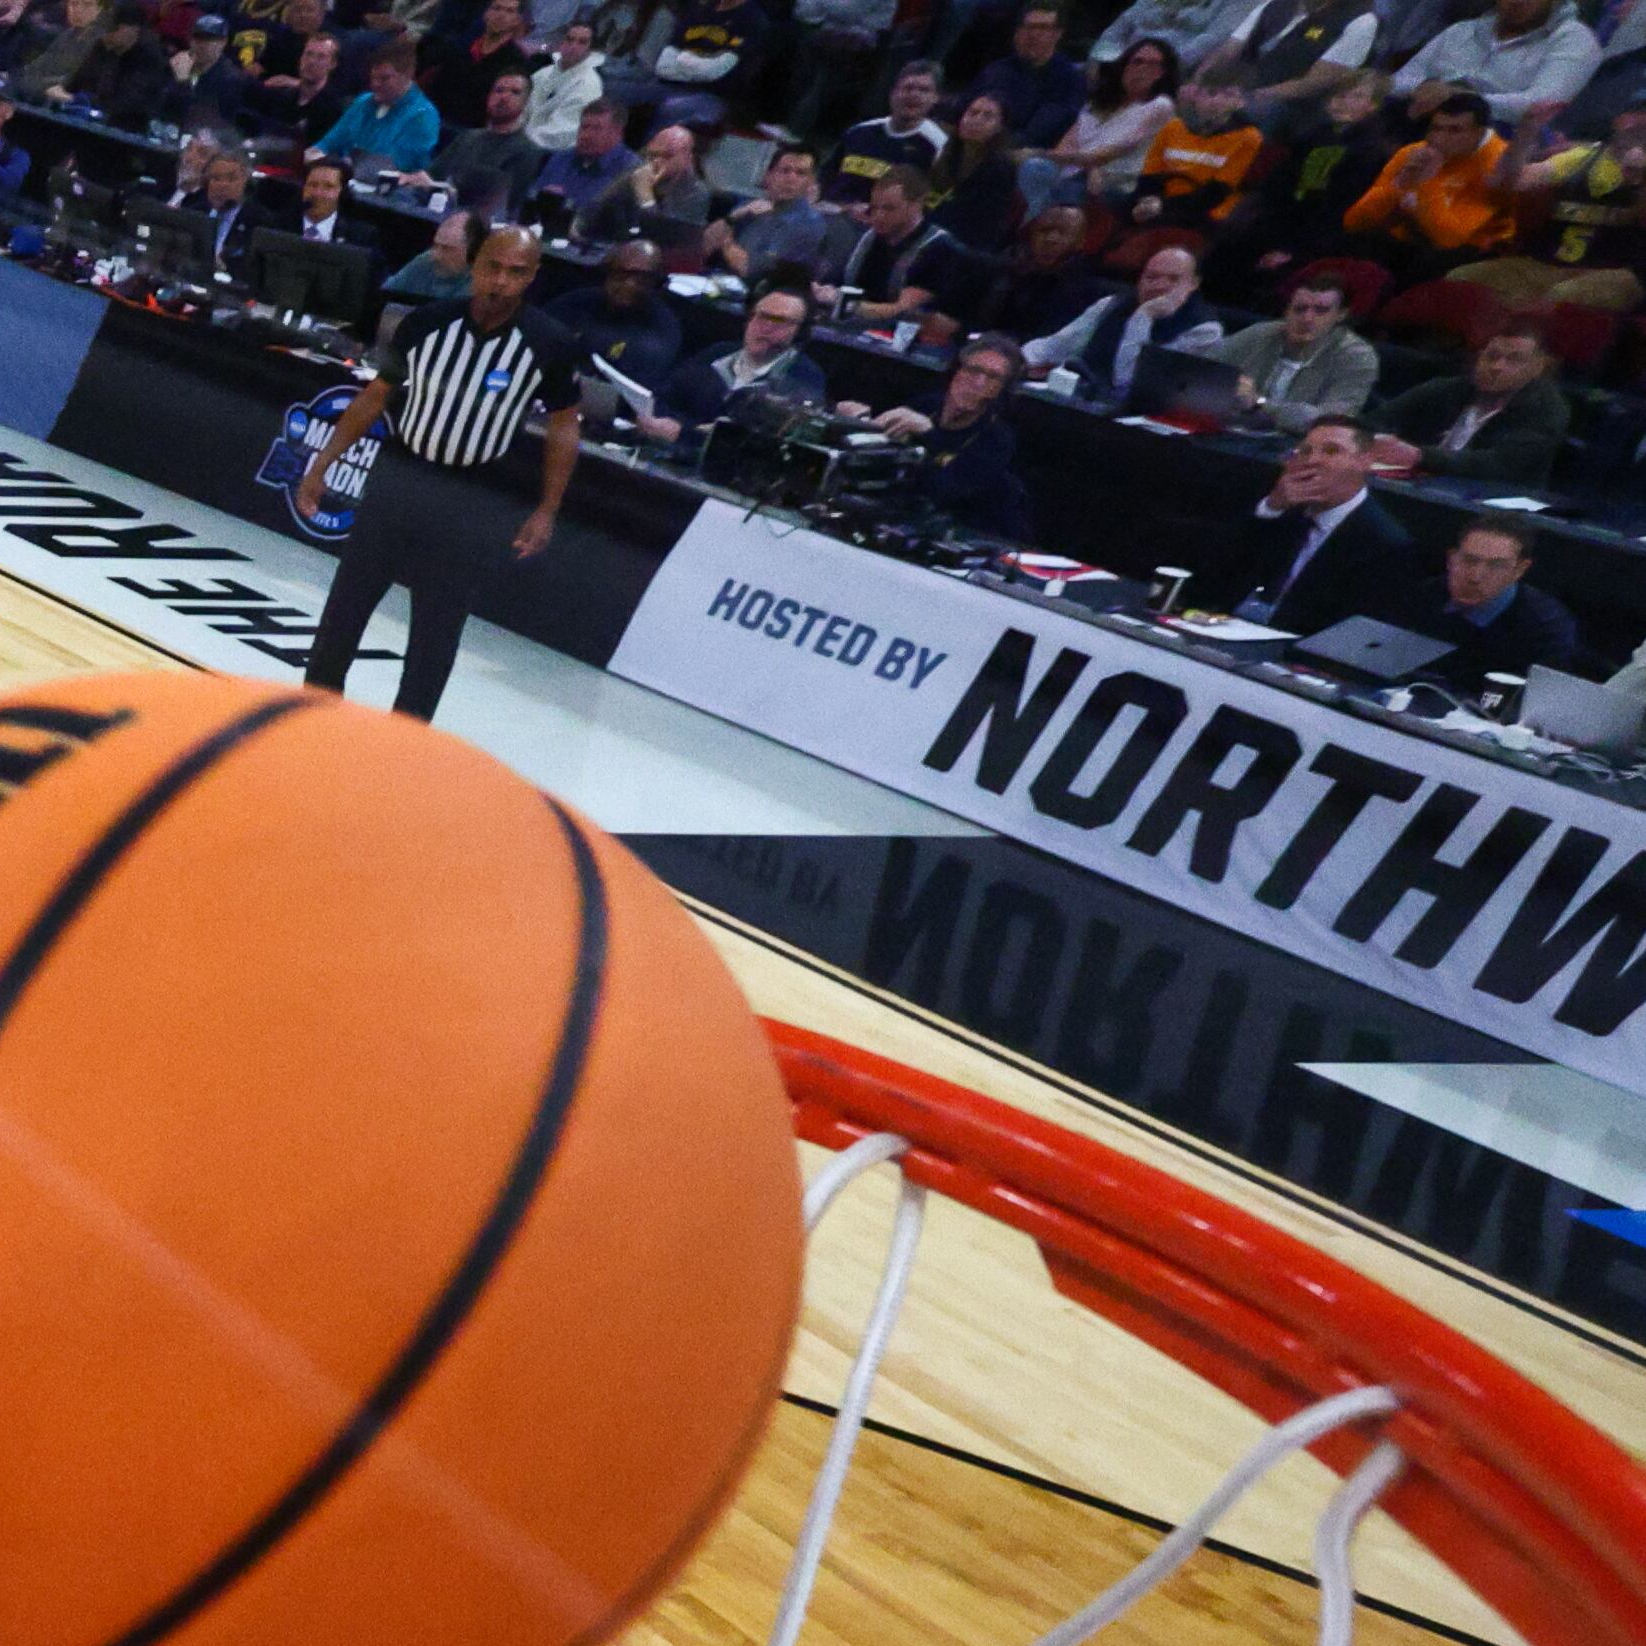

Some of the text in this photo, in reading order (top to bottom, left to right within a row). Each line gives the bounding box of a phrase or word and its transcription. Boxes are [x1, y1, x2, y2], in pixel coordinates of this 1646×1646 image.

[304, 418, 381, 469] MCH
[707, 578, 948, 689] HOSTED BY
